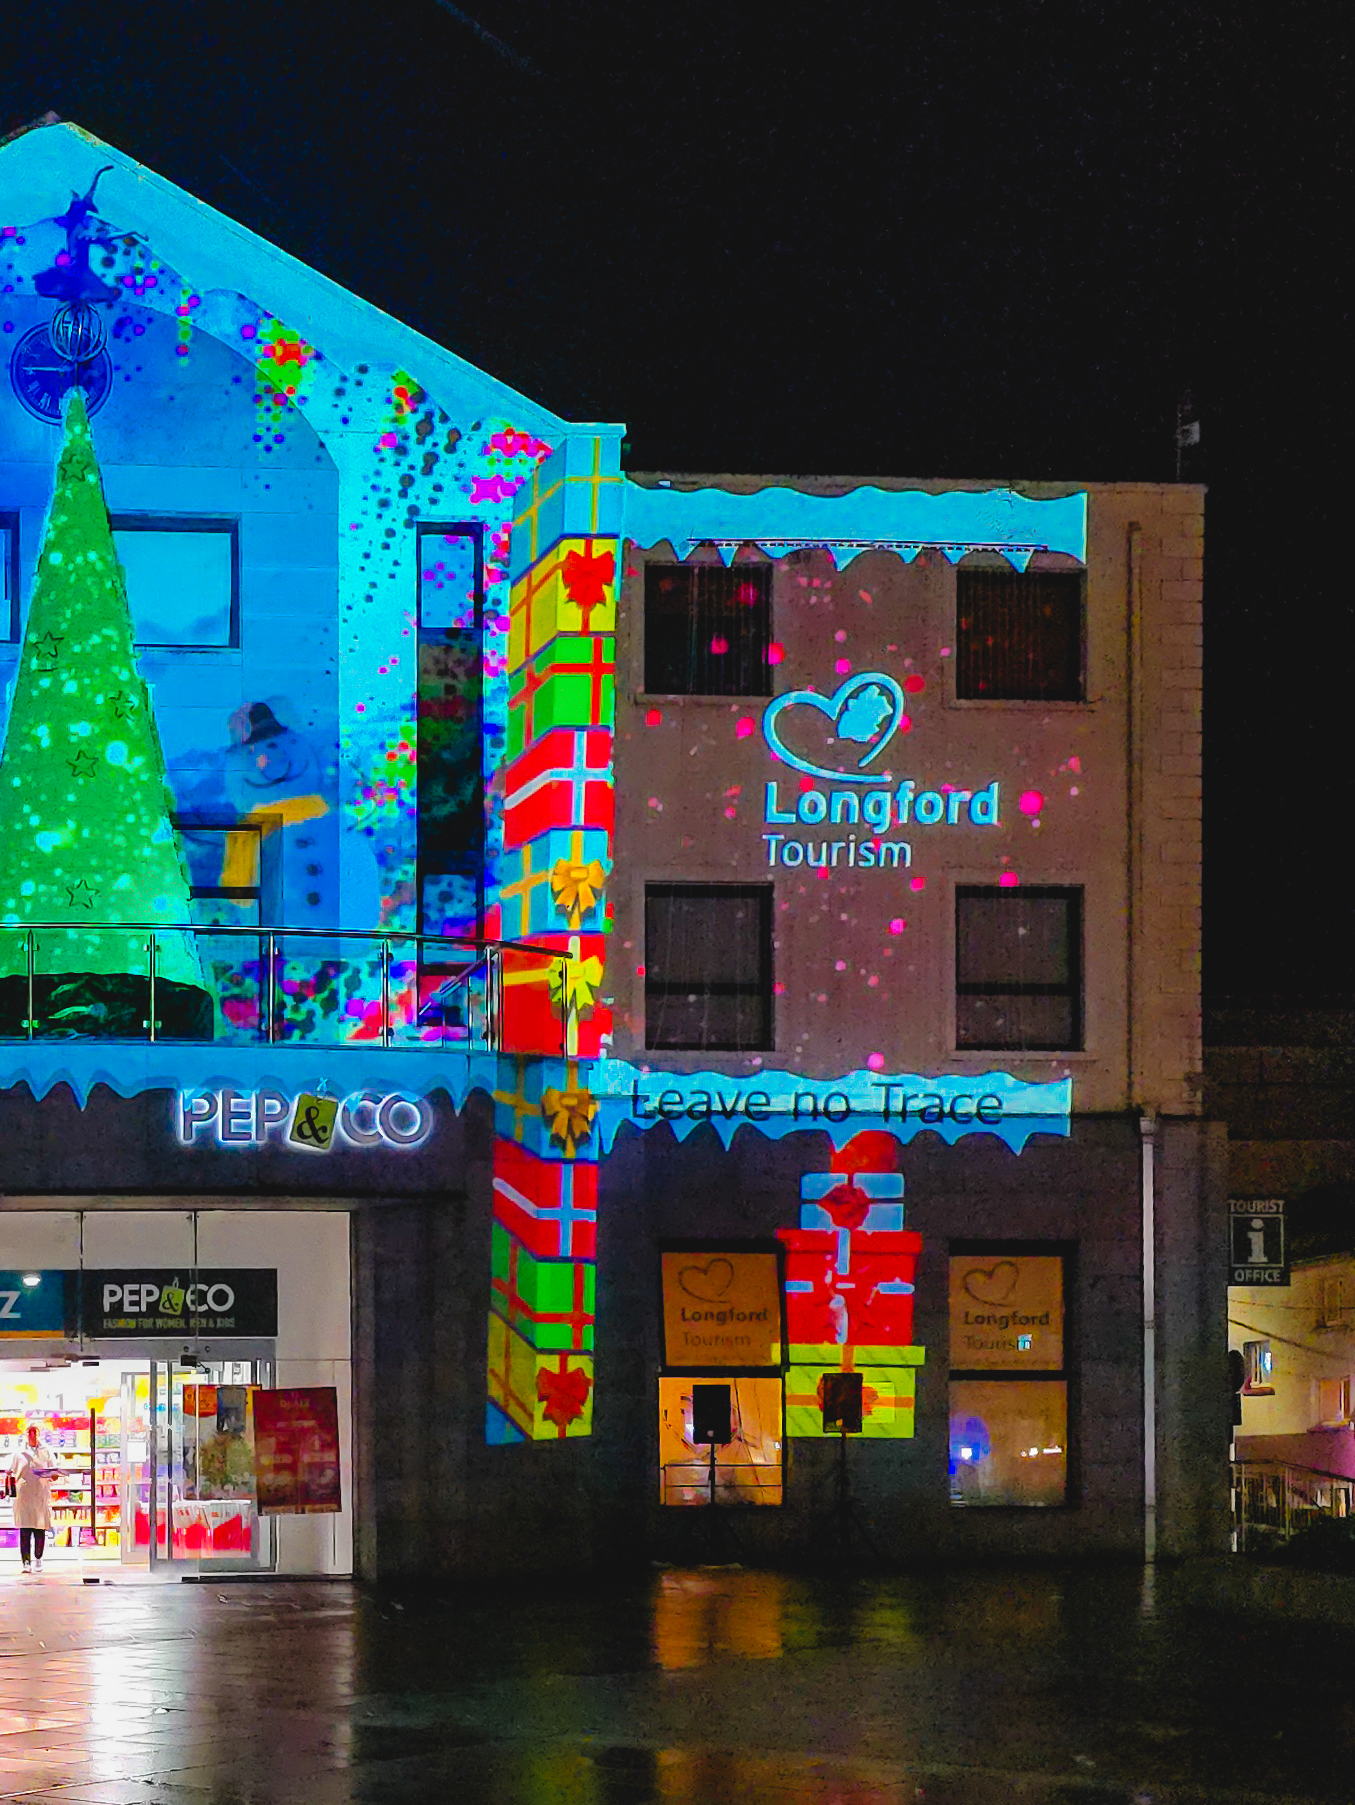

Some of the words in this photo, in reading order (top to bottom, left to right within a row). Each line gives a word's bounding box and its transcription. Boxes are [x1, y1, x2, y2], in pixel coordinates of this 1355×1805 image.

[763, 781, 1000, 834] Longford
[762, 833, 912, 868] Tourism
[631, 1079, 772, 1122] Leave
[794, 1090, 853, 1123] no
[870, 1082, 1004, 1124] Trace
[1226, 1199, 1285, 1213] TOURIST
[1234, 1269, 1282, 1282] OFFICE
[680, 1306, 768, 1327] Longford
[964, 1310, 1051, 1331] Longford
[682, 1331, 752, 1347] Tourism
[964, 1334, 1033, 1351] Touris
